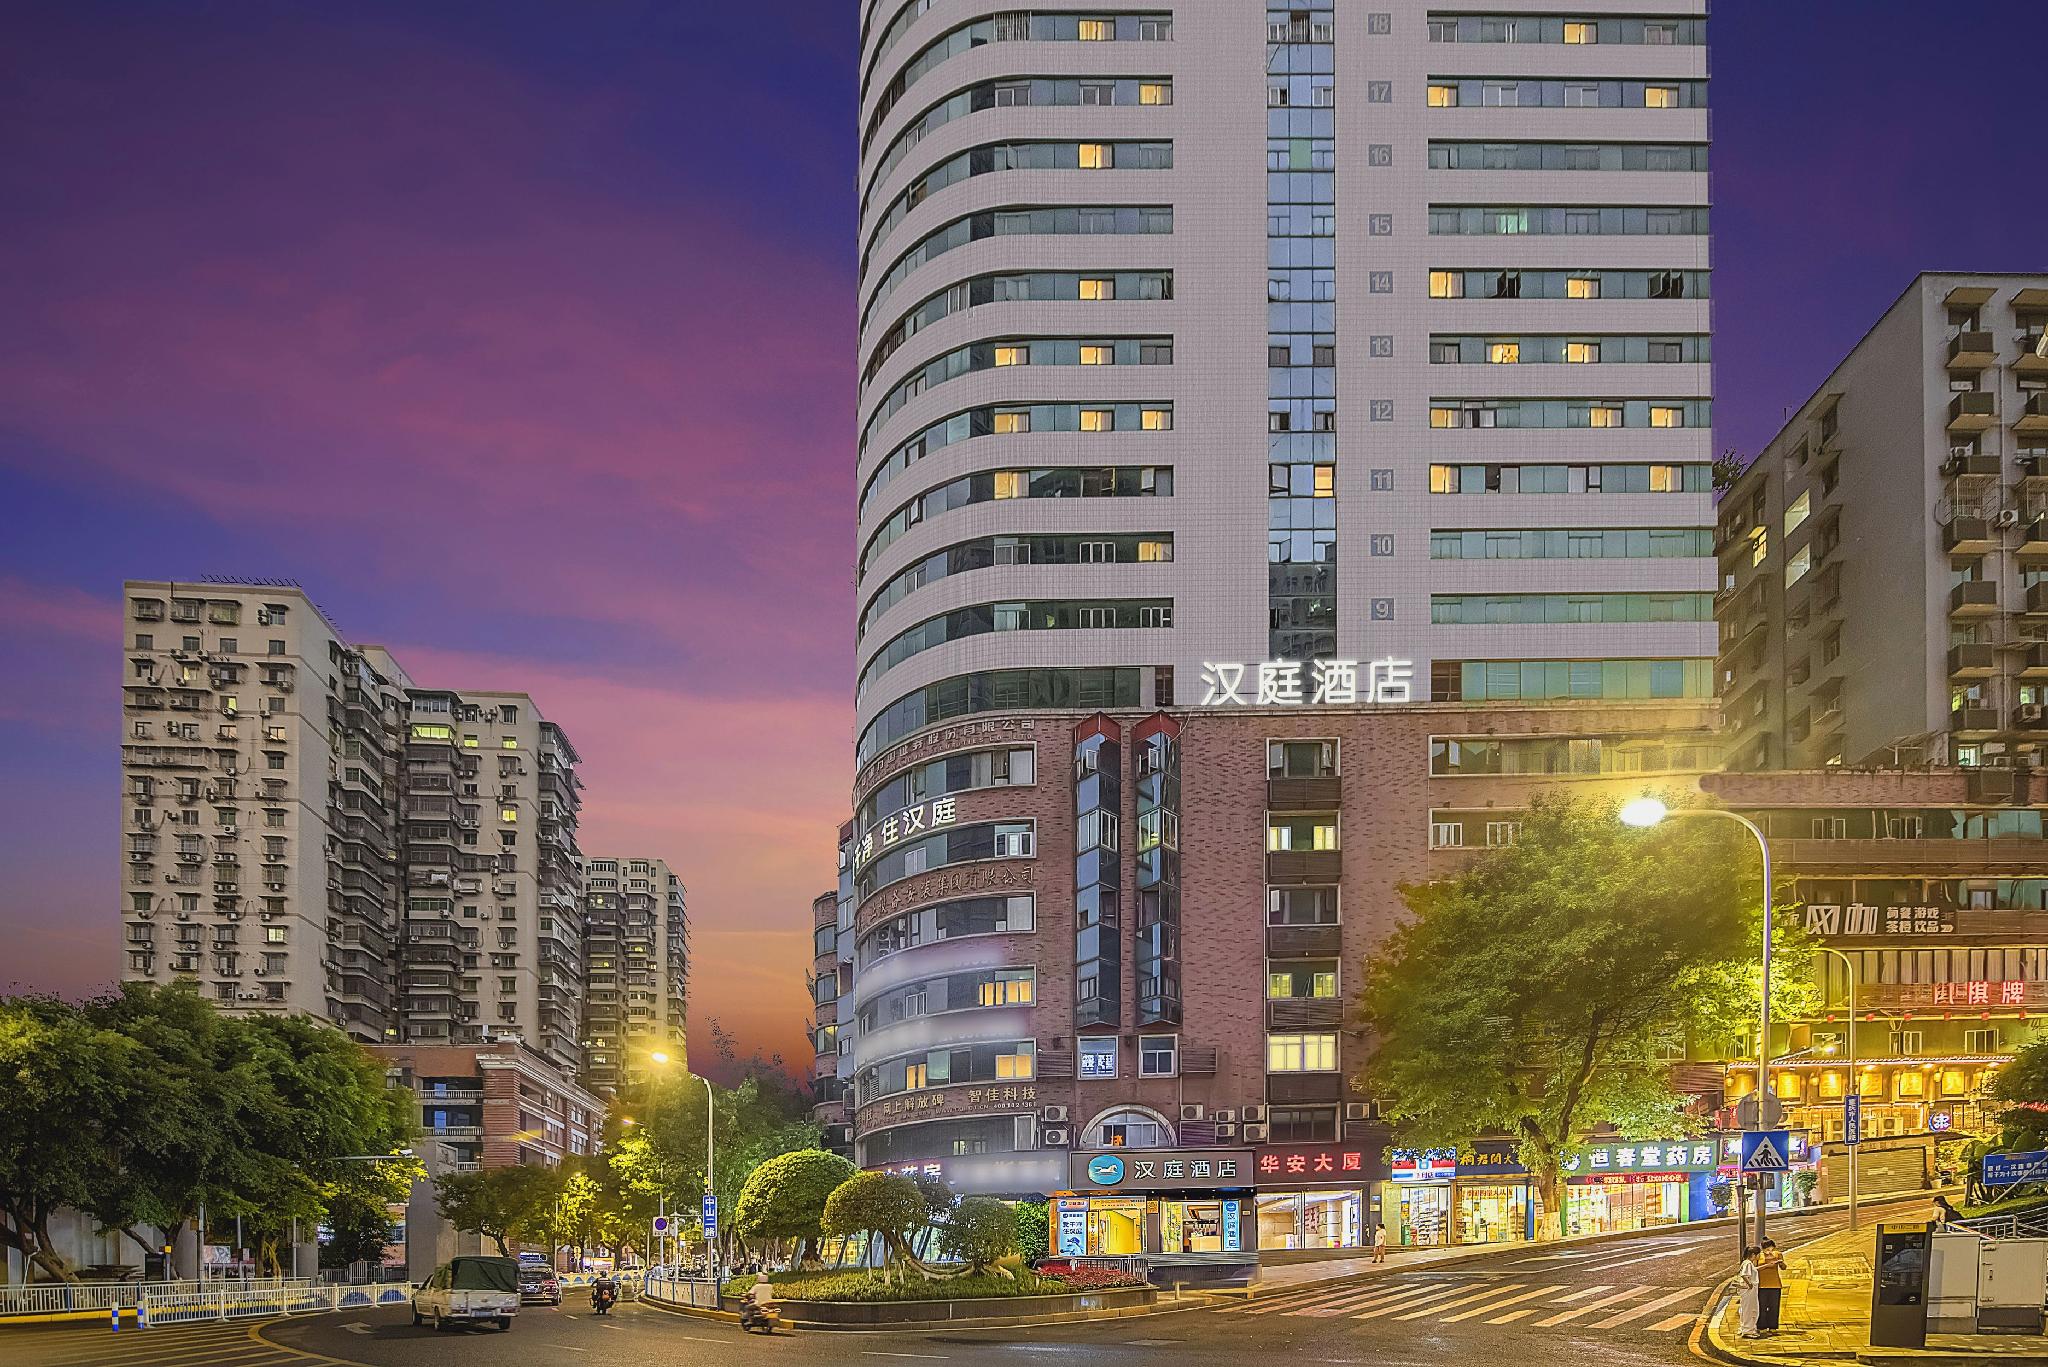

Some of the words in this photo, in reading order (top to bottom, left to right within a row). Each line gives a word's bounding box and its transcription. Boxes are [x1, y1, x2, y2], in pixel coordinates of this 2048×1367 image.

[1371, 14, 1389, 33] 18
[1371, 82, 1390, 101] 17
[1372, 145, 1390, 165] 16
[1372, 215, 1391, 235] 15
[1373, 273, 1391, 292] 14
[1372, 337, 1391, 356] 13
[1372, 401, 1392, 420] 12
[1374, 471, 1392, 490] 11
[1374, 535, 1392, 555] 10
[1376, 600, 1389, 618] 9
[1200, 656, 1414, 706] 汉庭酒店
[1806, 903, 1878, 935] 网咖
[1914, 906, 1940, 920] 游戏
[1914, 920, 1939, 933] 饮品
[968, 1086, 1037, 1103] 智佳科技
[1260, 1152, 1362, 1174] 华安大厦
[1460, 1152, 1520, 1166] 桐君阁大
[1588, 1145, 1712, 1168] 恒春堂药房
[1134, 1160, 1237, 1180] 汉庭酒店
[705, 1196, 715, 1237] 中山二路
